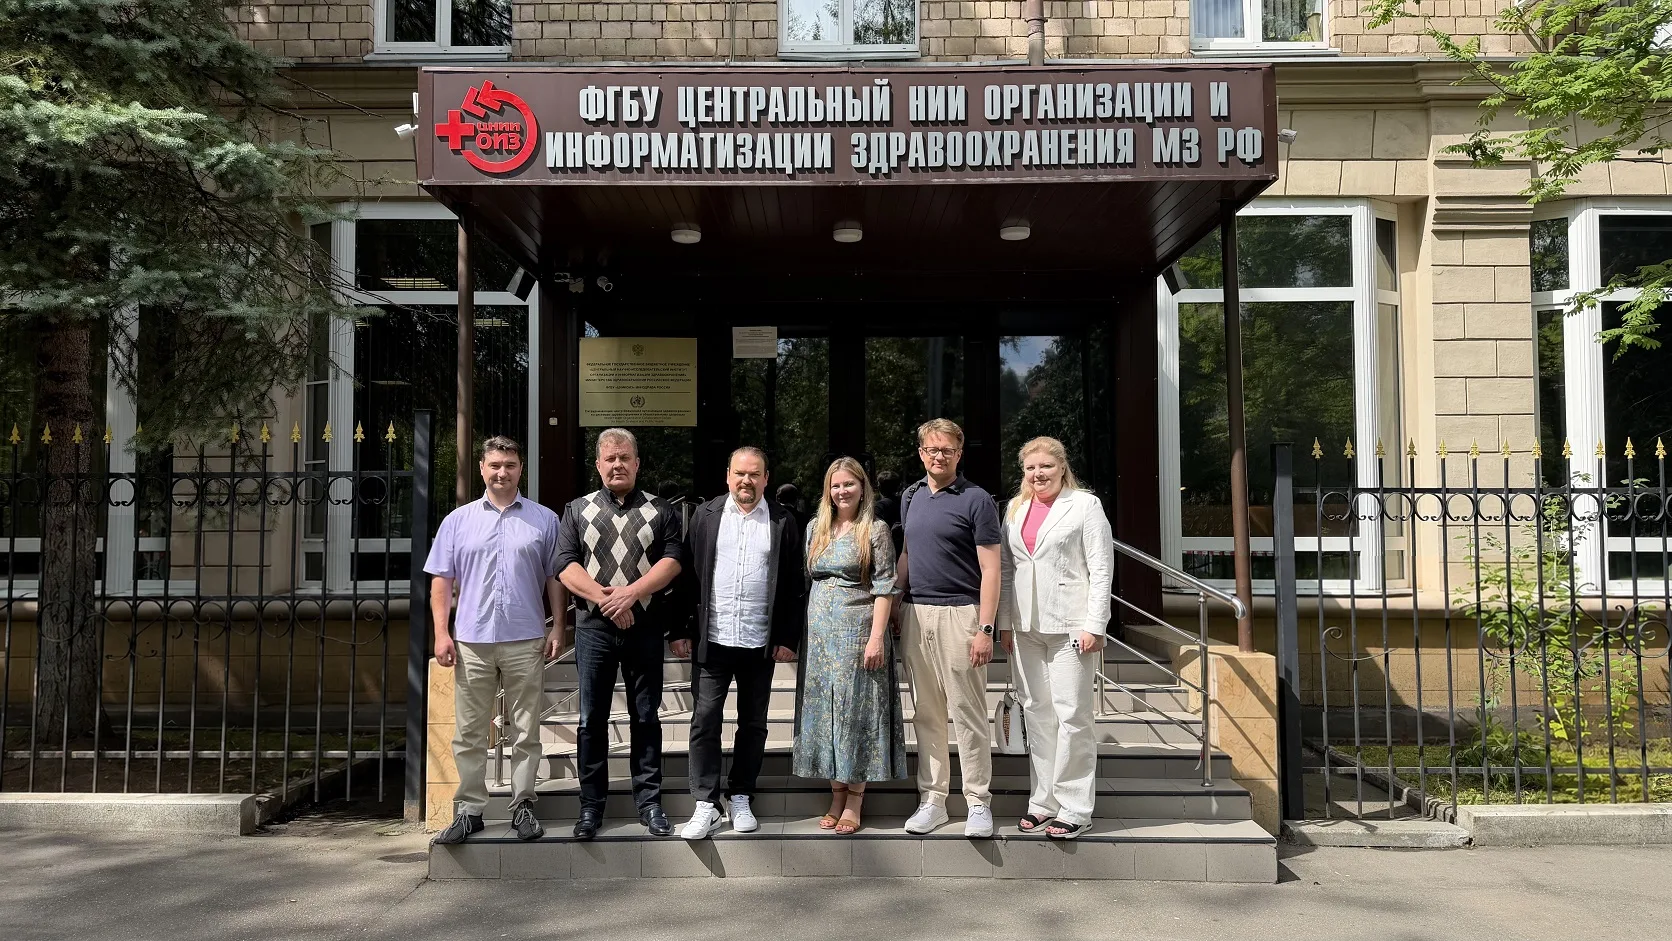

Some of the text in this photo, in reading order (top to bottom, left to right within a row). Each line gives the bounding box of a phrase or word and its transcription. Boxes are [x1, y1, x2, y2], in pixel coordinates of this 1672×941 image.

[579, 79, 1227, 127] ФГБУ ЦЕНТРАЛЬНЫЙ НИИ ОРГАНИЗАЦИИ И
[475, 133, 522, 151] ОИЗ
[546, 127, 1261, 175] ИНФОРМАТИЗАЦИИ ЗДРАВООХРАНЕНИЯ МЗ РФ
